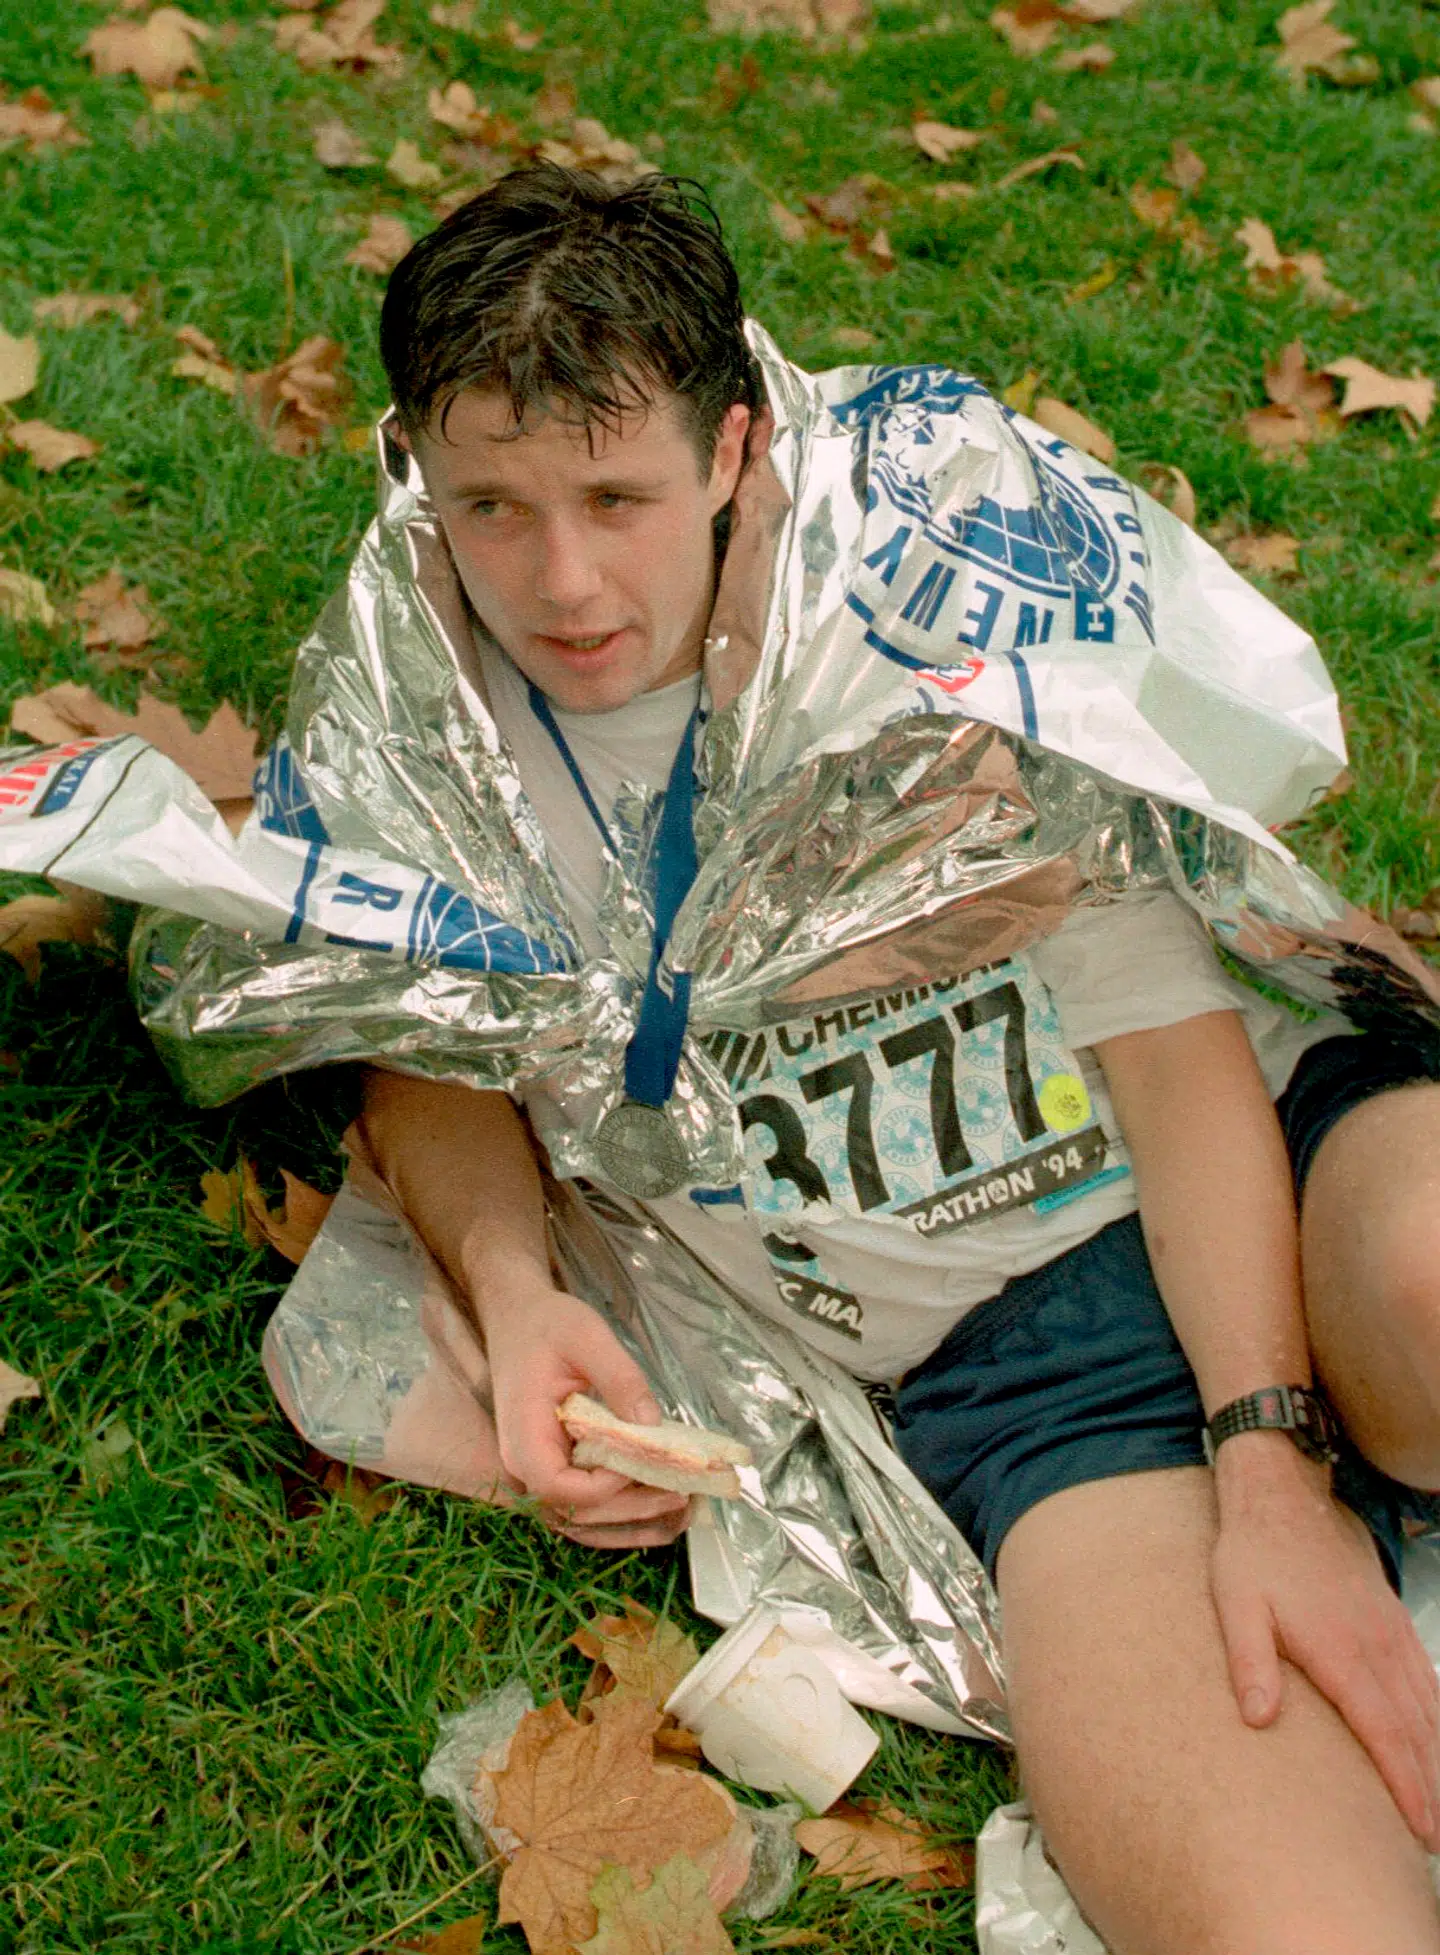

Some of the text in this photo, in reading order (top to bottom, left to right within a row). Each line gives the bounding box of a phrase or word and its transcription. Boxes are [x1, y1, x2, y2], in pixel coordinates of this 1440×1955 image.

[899, 559, 1055, 652] NEW
[737, 980, 1048, 1213] 3777
[1041, 1146, 1084, 1180] '94
